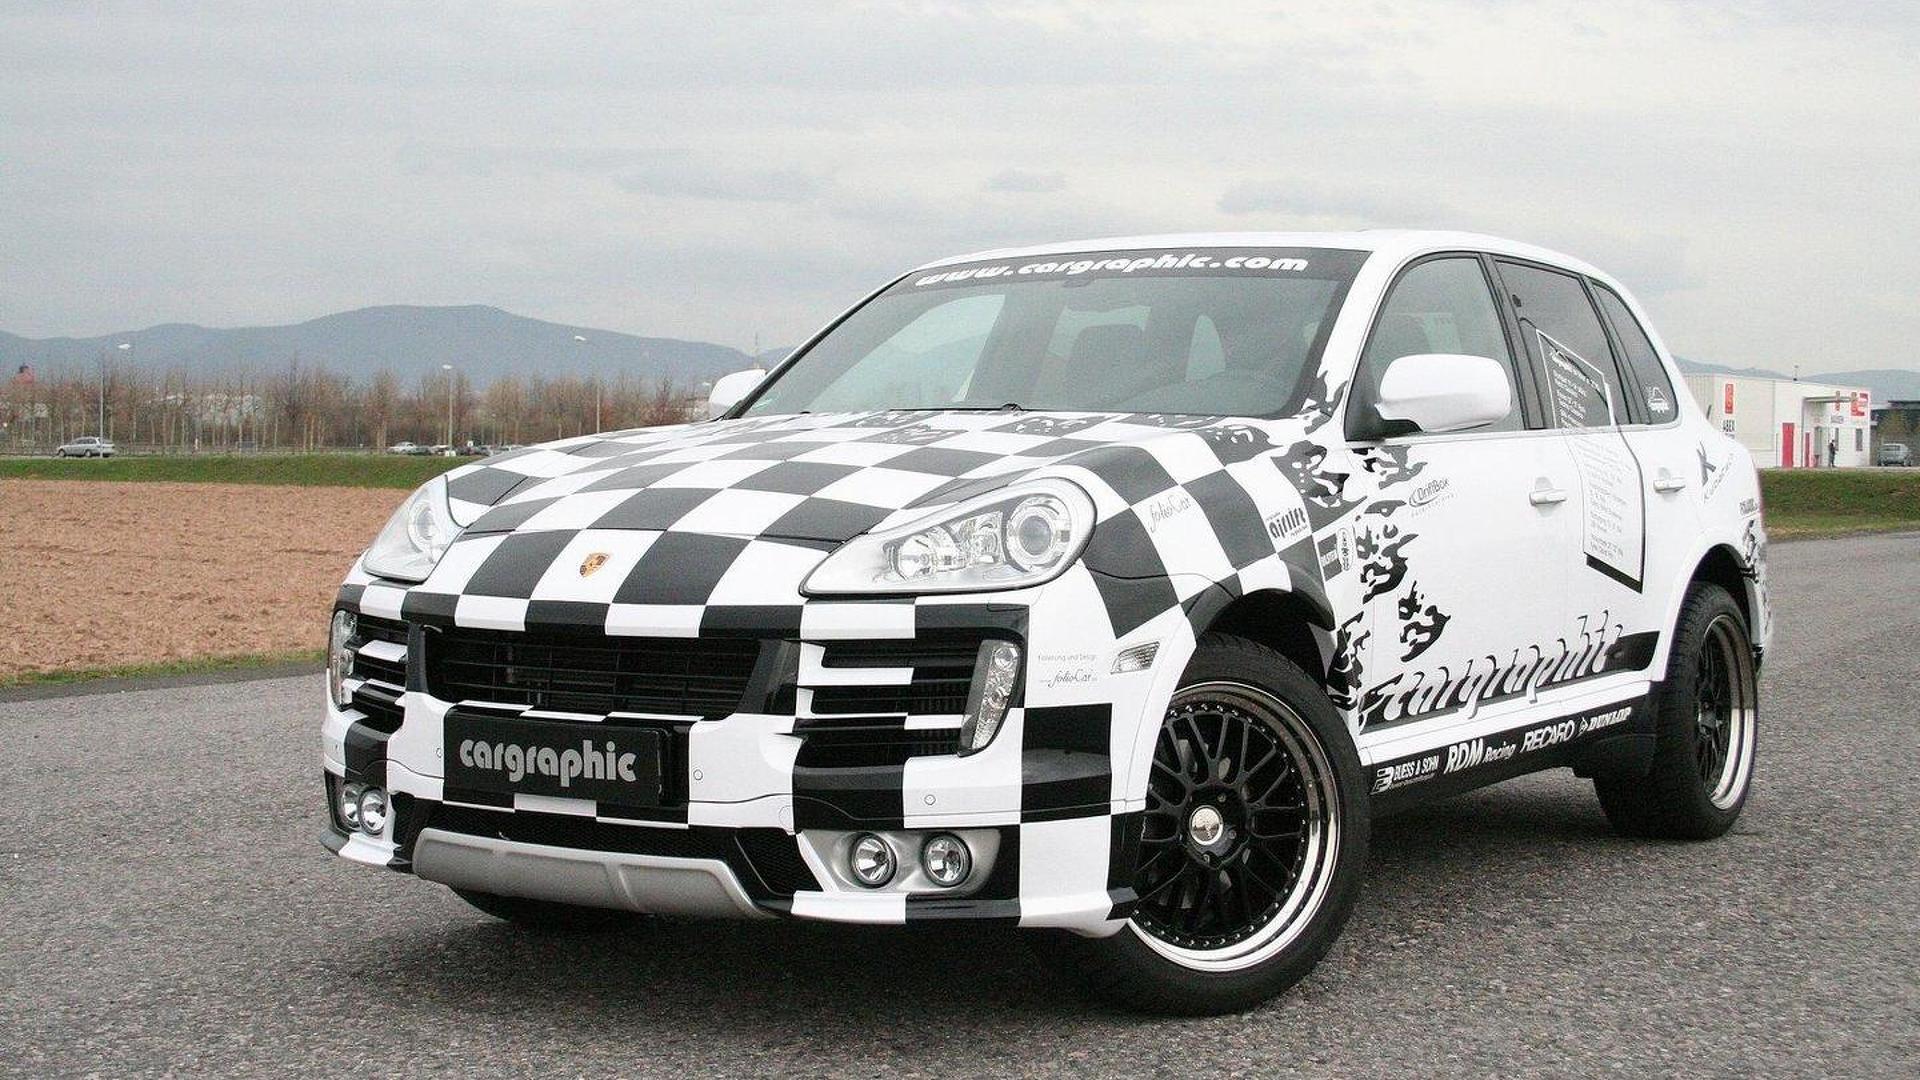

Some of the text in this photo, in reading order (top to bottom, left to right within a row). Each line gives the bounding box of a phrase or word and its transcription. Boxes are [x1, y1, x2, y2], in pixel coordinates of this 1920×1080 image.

[915, 253, 1310, 287] www.cargraphic.com
[459, 738, 638, 788] cargraphic
[1443, 738, 1485, 775] RDM
[1519, 719, 1576, 754] RECARO
[1586, 706, 1633, 732] DUNLOP
